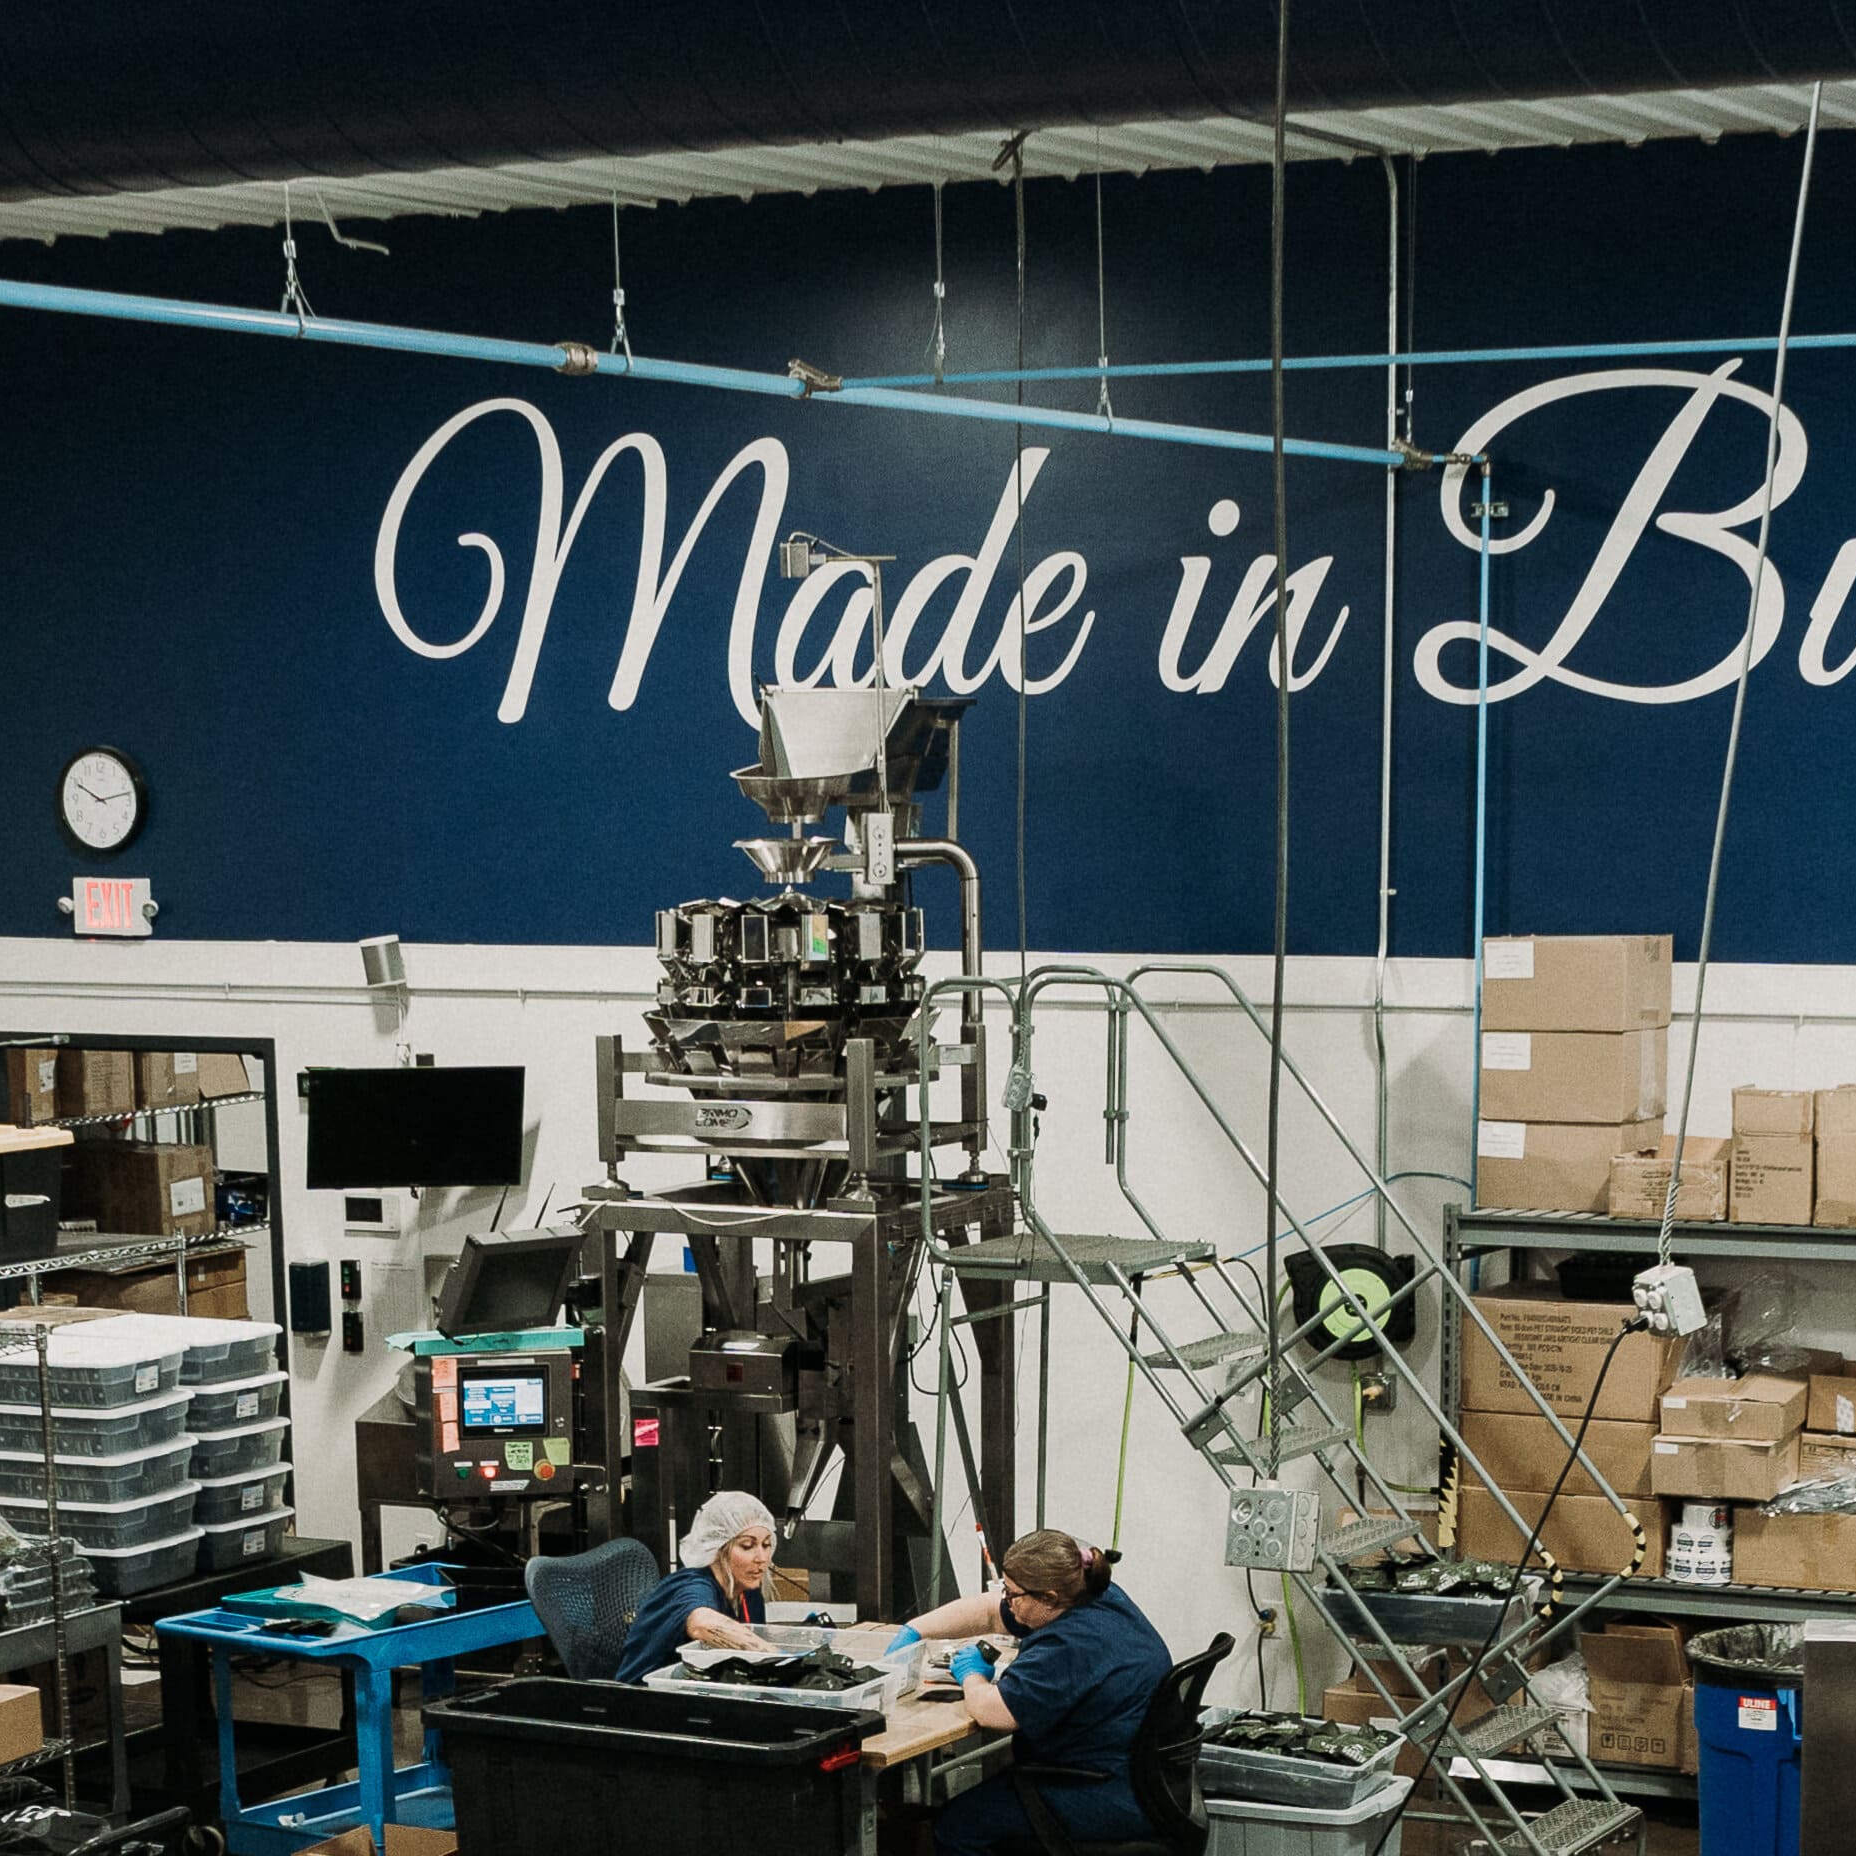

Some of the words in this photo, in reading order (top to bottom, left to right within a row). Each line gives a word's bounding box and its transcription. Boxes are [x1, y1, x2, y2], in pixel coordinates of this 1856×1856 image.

[374, 397, 1096, 730] Made
[1157, 498, 1349, 694] in
[86, 881, 134, 929] EXIT
[1743, 1699, 1771, 1709] ULINE
